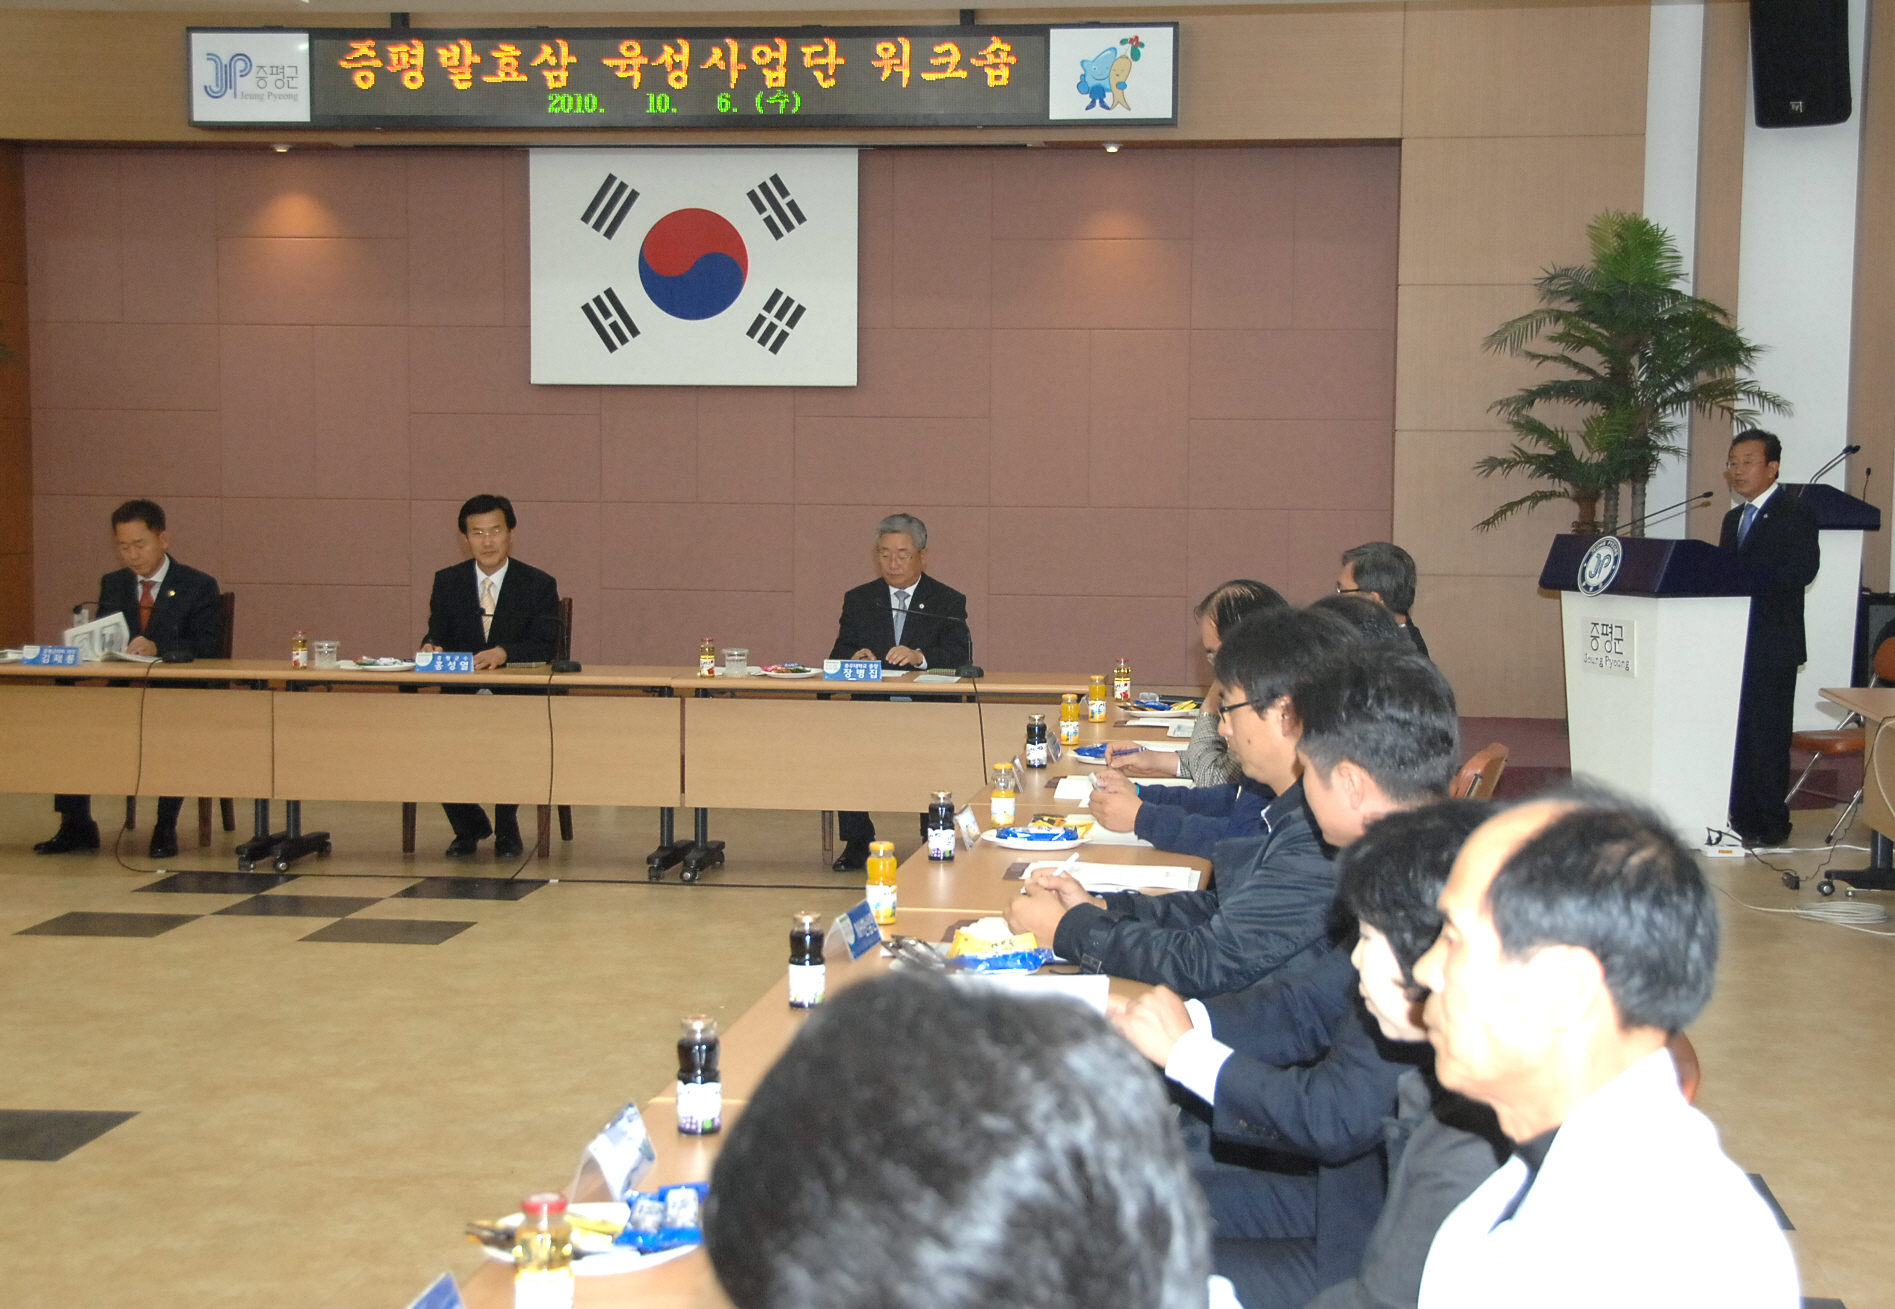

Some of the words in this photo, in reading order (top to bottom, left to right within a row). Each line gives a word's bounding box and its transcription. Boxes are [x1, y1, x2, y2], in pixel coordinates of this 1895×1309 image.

[339, 39, 577, 90] 증평발효삼
[602, 38, 845, 90] 육성사업단
[871, 36, 1017, 88] 워크숍
[255, 65, 299, 90] 증평군
[240, 91, 265, 102] Jeung
[267, 91, 299, 102] Pyeong
[548, 93, 605, 114] 2010.
[646, 93, 678, 114] 10.
[717, 92, 739, 113] 6.
[755, 90, 801, 114] (수)
[1590, 622, 1624, 655] 증평군
[435, 661, 469, 671] 홍성열
[843, 669, 878, 679] 장병집
